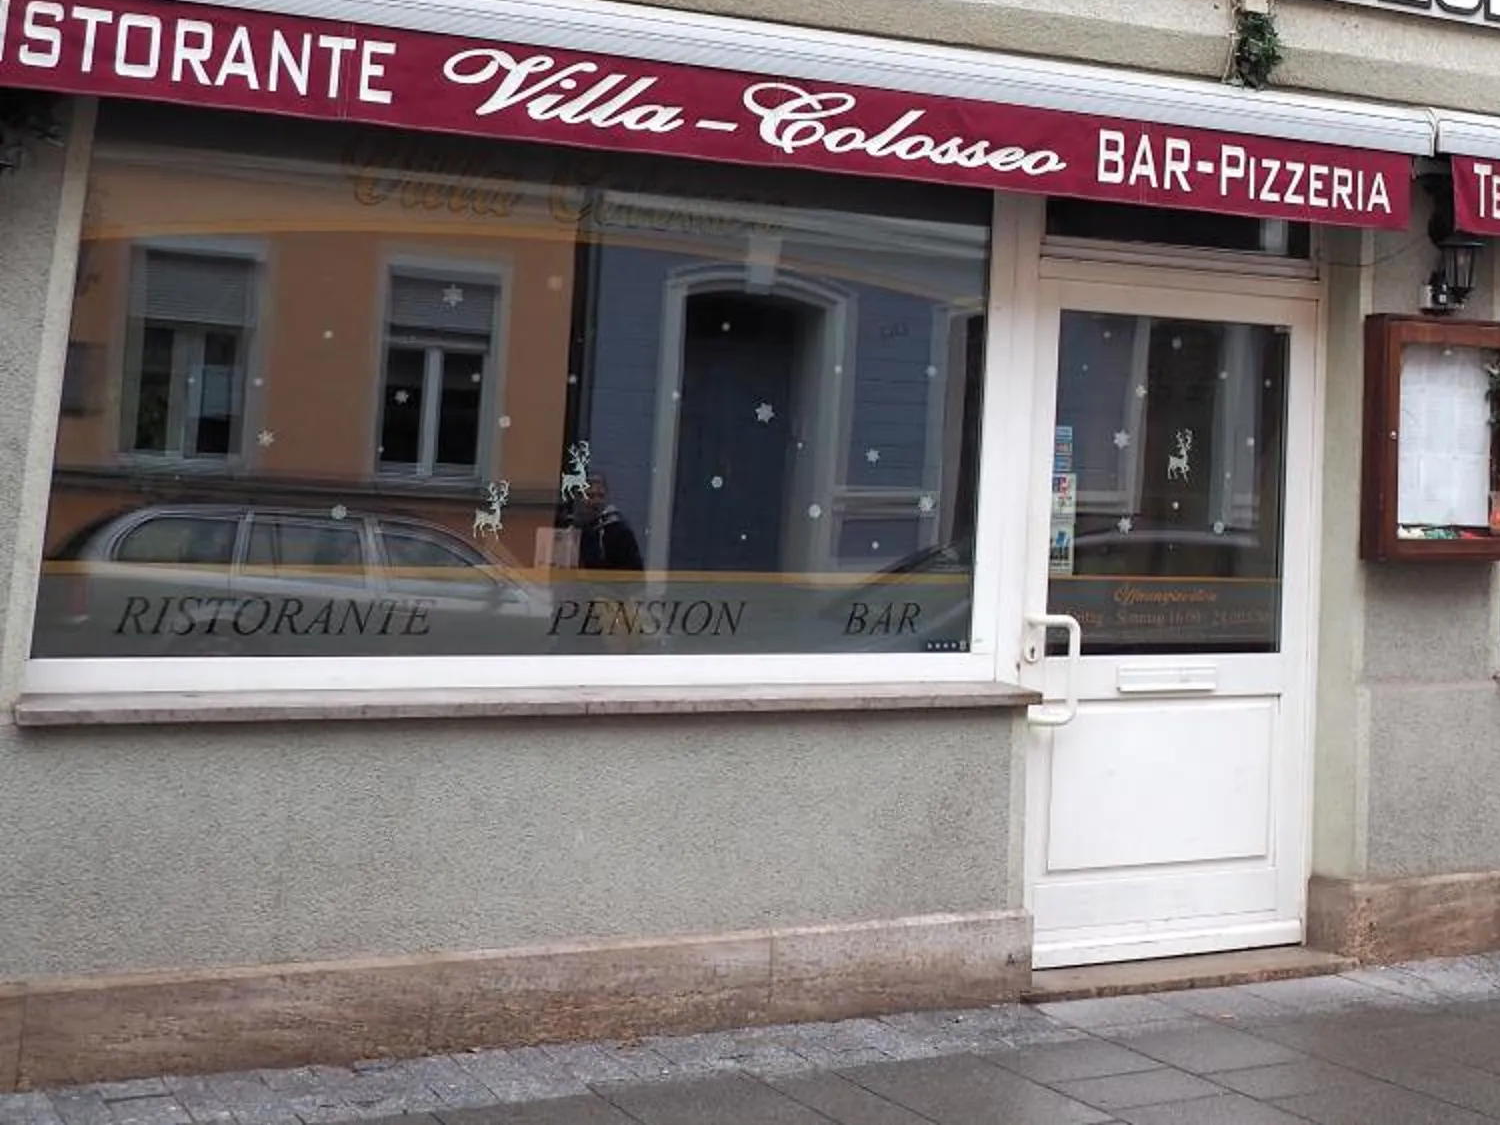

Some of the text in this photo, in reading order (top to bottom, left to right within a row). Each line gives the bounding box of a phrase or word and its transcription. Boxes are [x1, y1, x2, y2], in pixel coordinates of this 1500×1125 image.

[443, 48, 685, 133] Villa
[743, 82, 1067, 176] Colosseo
[1097, 129, 1391, 214] BAR-PIZZERIA
[112, 595, 923, 638] RISTORANTE PENSION BAR
